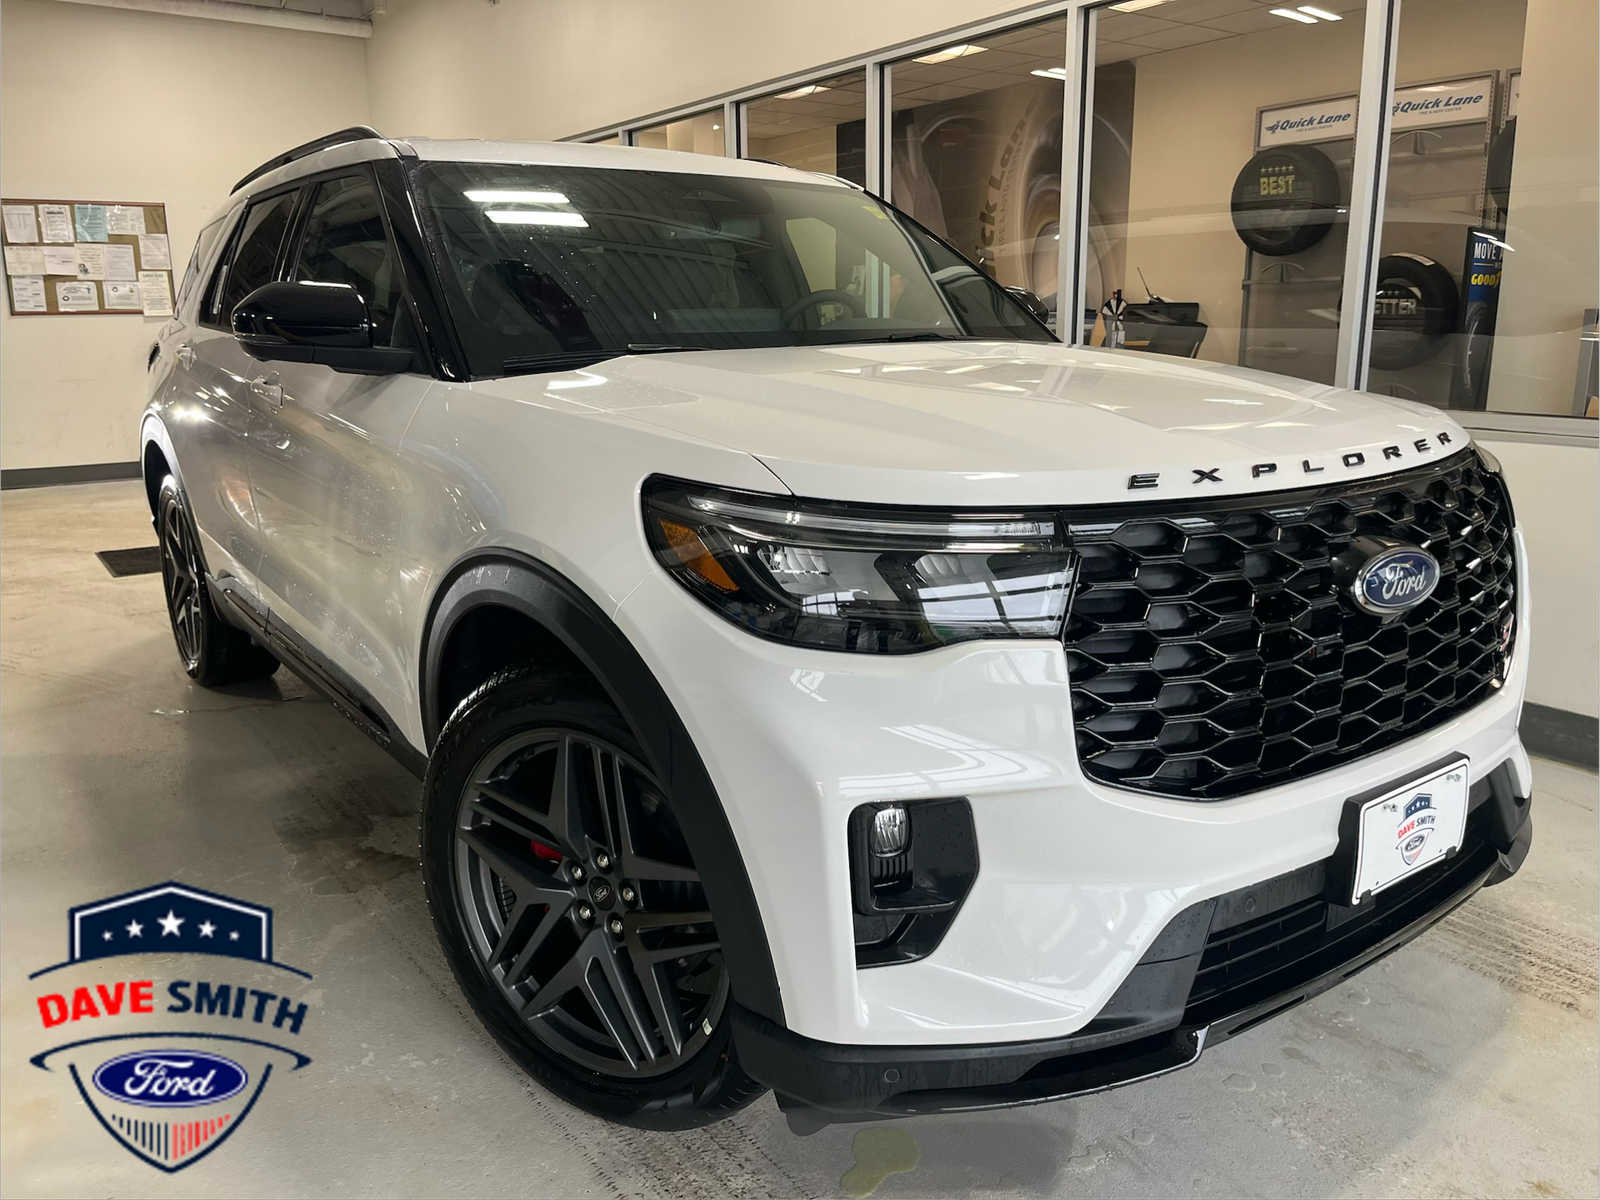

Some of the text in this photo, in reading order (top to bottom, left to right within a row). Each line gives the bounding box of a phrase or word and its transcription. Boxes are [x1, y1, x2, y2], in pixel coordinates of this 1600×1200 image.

[1400, 98, 1442, 113] Quick
[1443, 94, 1483, 108] Lane
[1279, 116, 1317, 131] Quick
[1317, 112, 1351, 125] Lane
[1260, 174, 1296, 196] BEST
[1473, 242, 1496, 260] MOVE
[1375, 298, 1417, 316] ETTER
[1127, 431, 1453, 490] EXPLORER
[1382, 563, 1427, 600] Ford
[1397, 815, 1436, 839] DAVE SMITH
